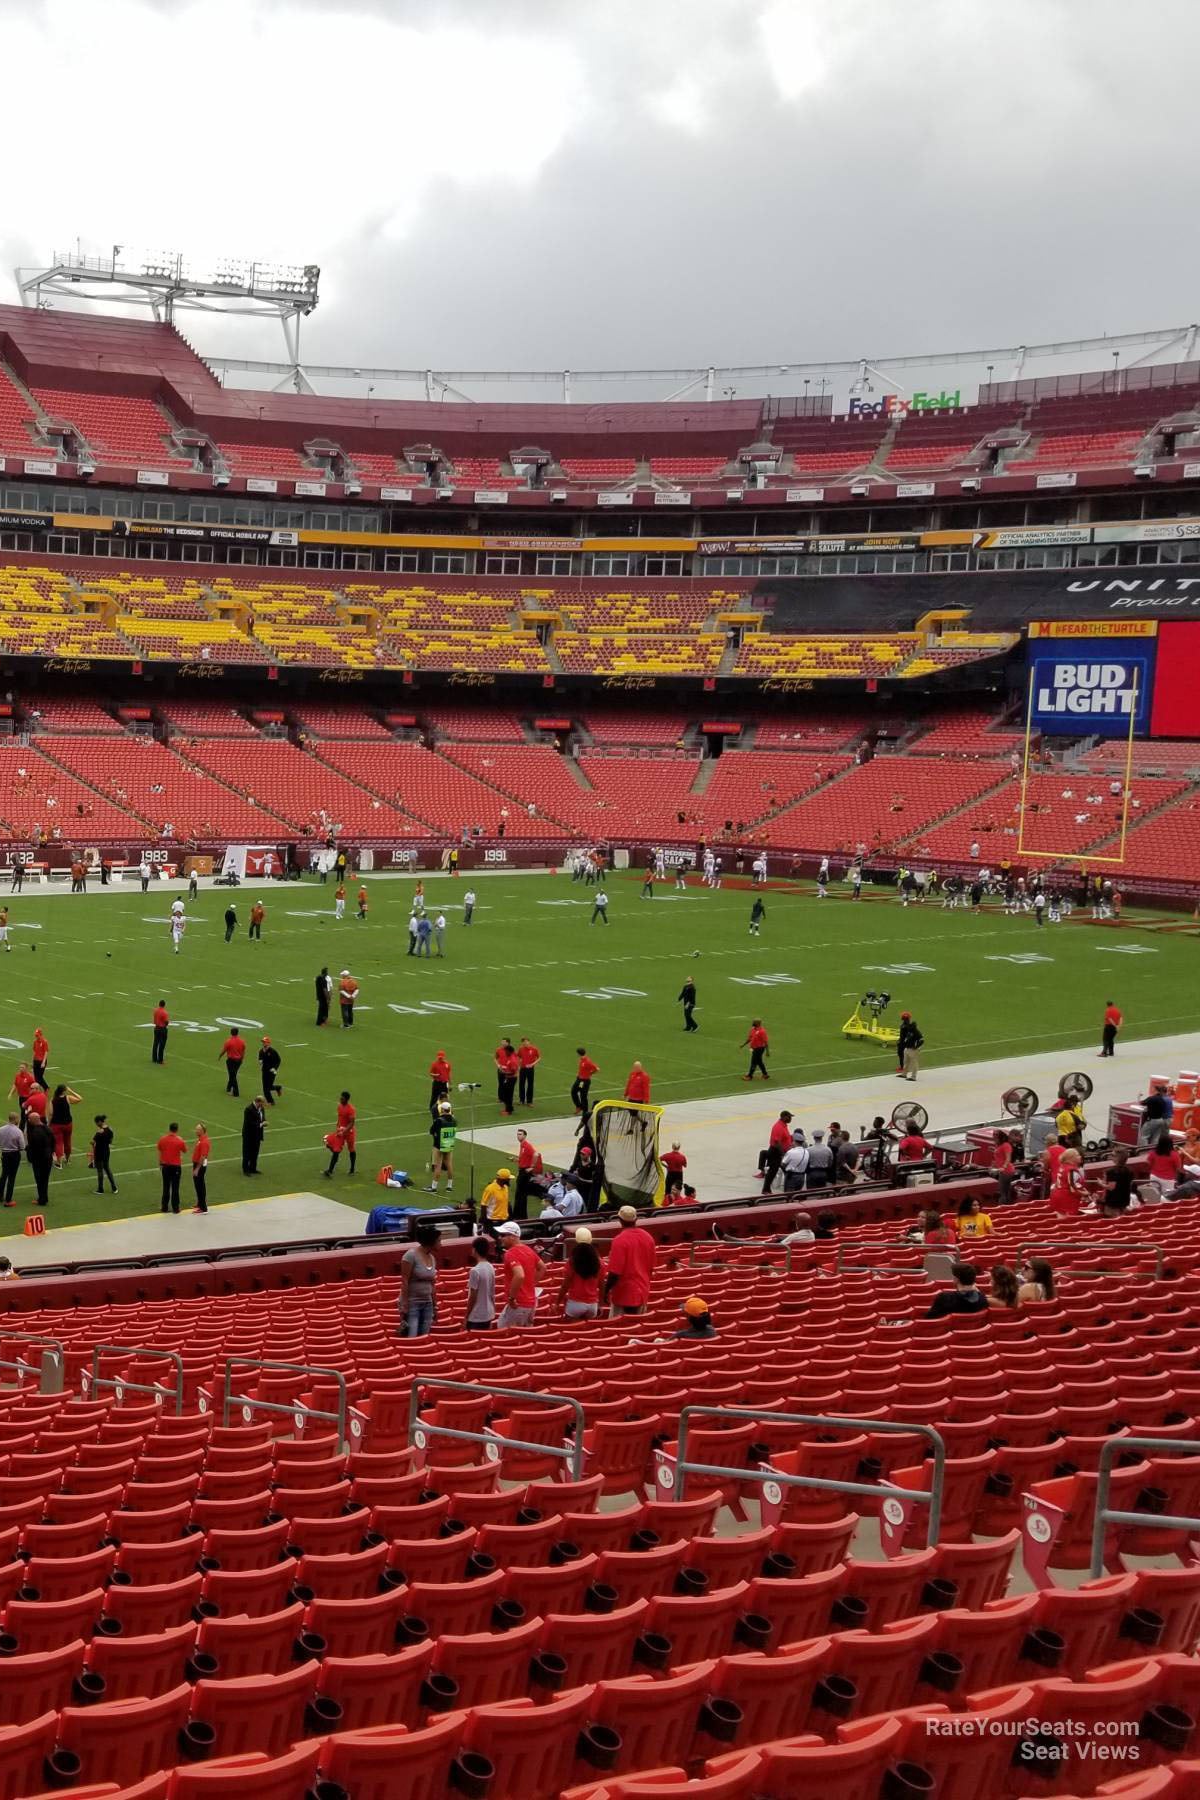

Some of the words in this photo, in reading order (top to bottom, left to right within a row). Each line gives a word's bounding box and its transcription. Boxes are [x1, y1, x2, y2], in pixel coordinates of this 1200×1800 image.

[849, 391, 960, 418] FedExField
[20, 517, 46, 527] VODKA
[210, 530, 235, 538] OFFICIAL
[818, 544, 846, 553] SALUTE
[1110, 596, 1188, 608] Proud
[1054, 665, 1126, 688] BUD
[1038, 689, 1140, 713] LIGHT
[5, 851, 35, 865] 12
[140, 850, 168, 863] 1983
[392, 850, 411, 862] 198
[484, 849, 507, 862] 1991
[663, 856, 697, 865] SALE
[862, 961, 937, 976] 30
[730, 972, 802, 987] 40
[561, 986, 649, 1000] 50
[386, 999, 471, 1016] 40
[174, 1016, 265, 1033] 30
[1183, 1111, 1194, 1130] G
[28, 1216, 43, 1234] 10
